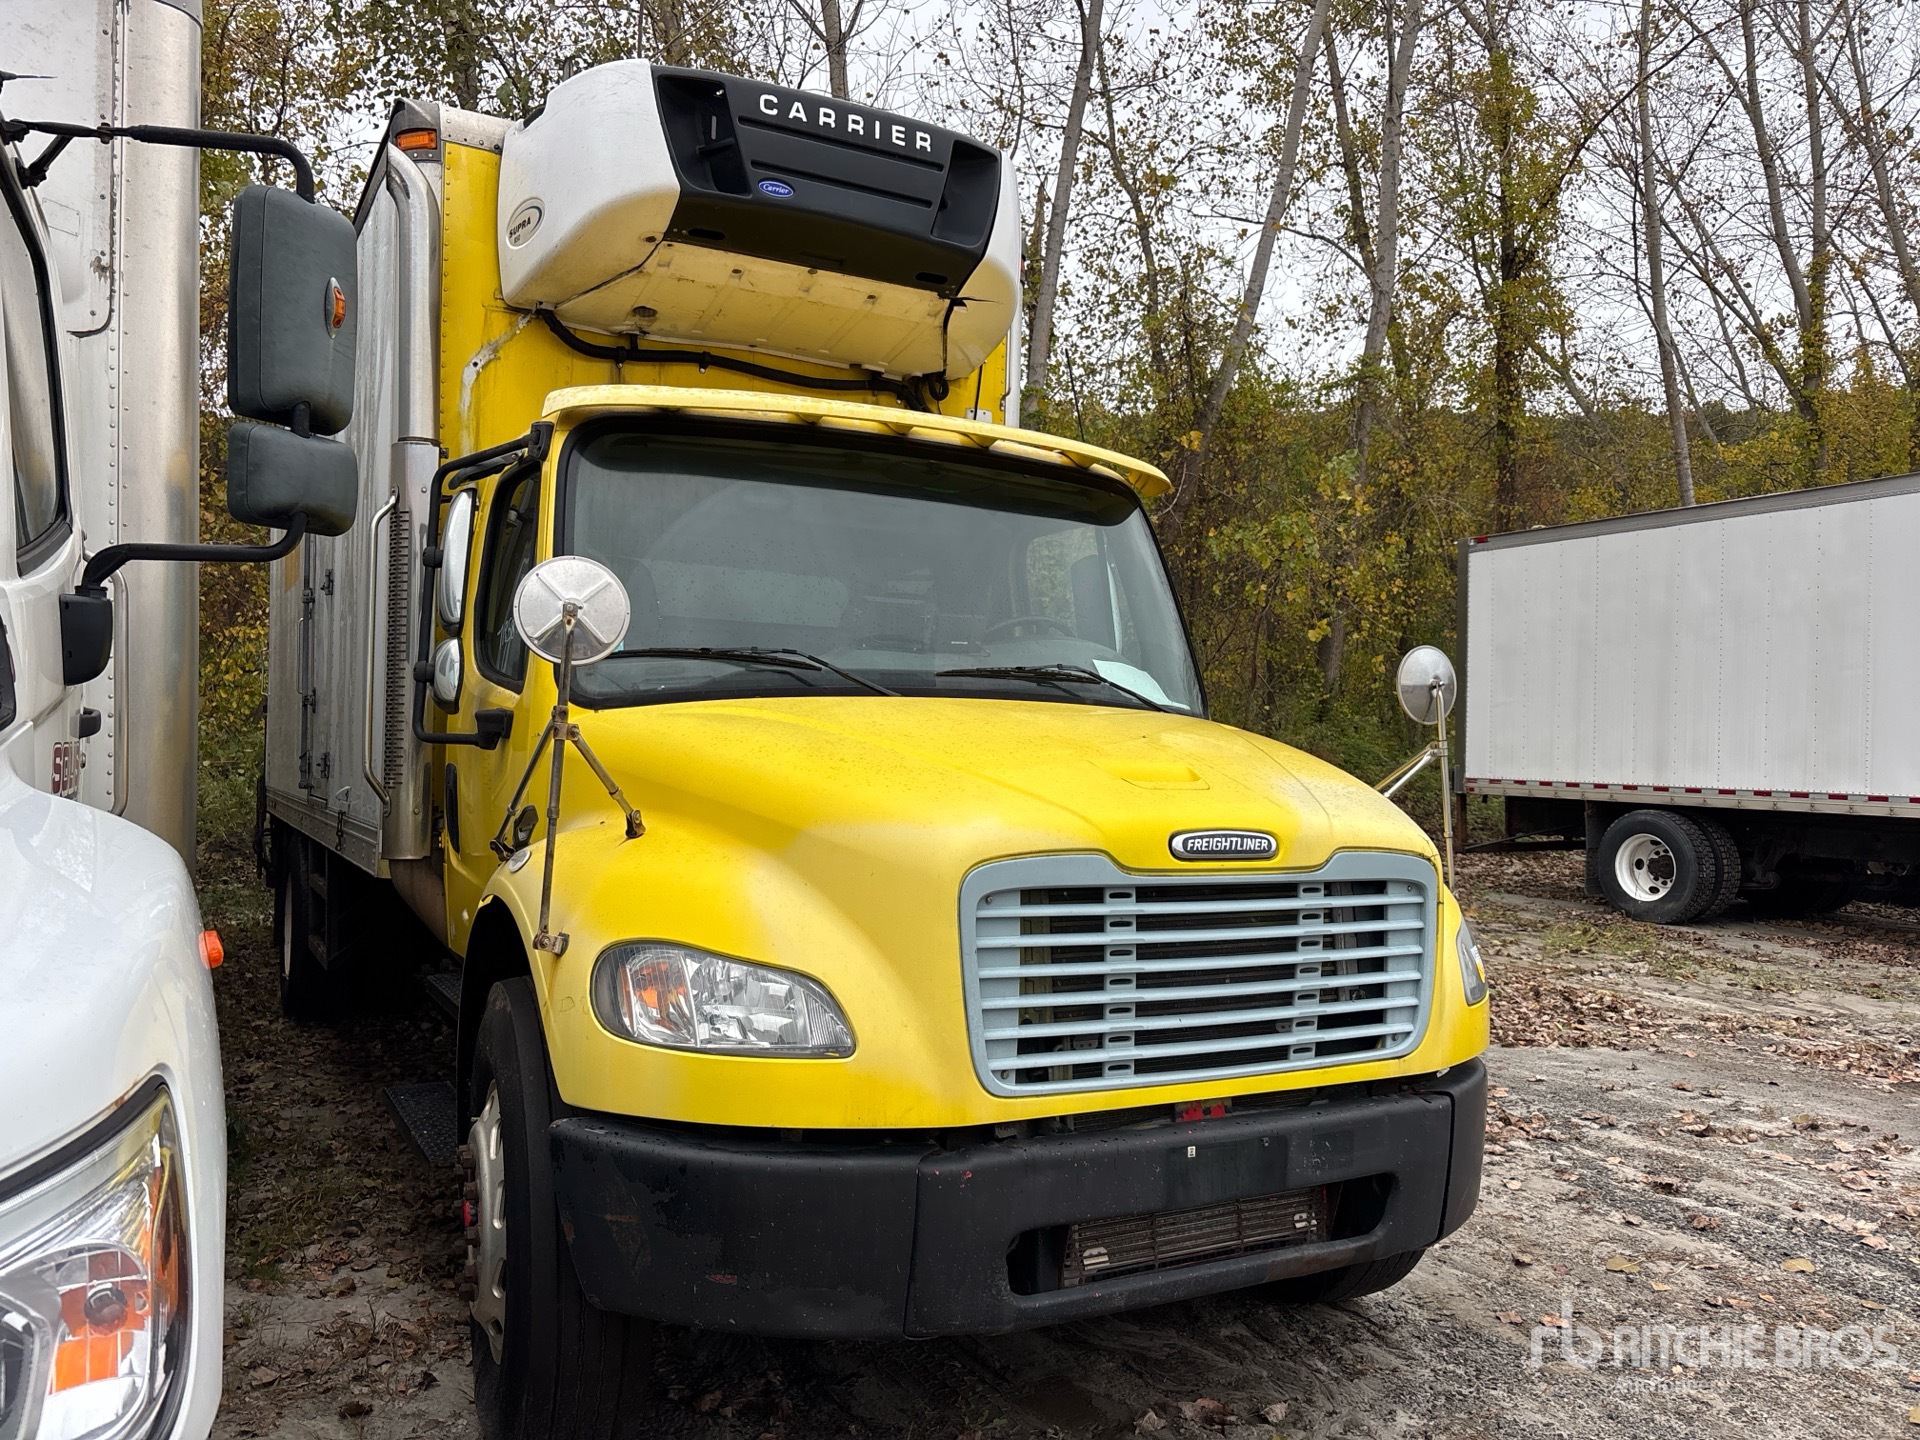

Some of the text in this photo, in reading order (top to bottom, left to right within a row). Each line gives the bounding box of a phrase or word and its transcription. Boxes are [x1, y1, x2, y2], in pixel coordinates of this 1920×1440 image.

[758, 94, 932, 152] CARRIER
[763, 183, 790, 195] Carrier
[509, 216, 531, 239] SUPRA
[1187, 837, 1269, 851] FREIGHTLINER
